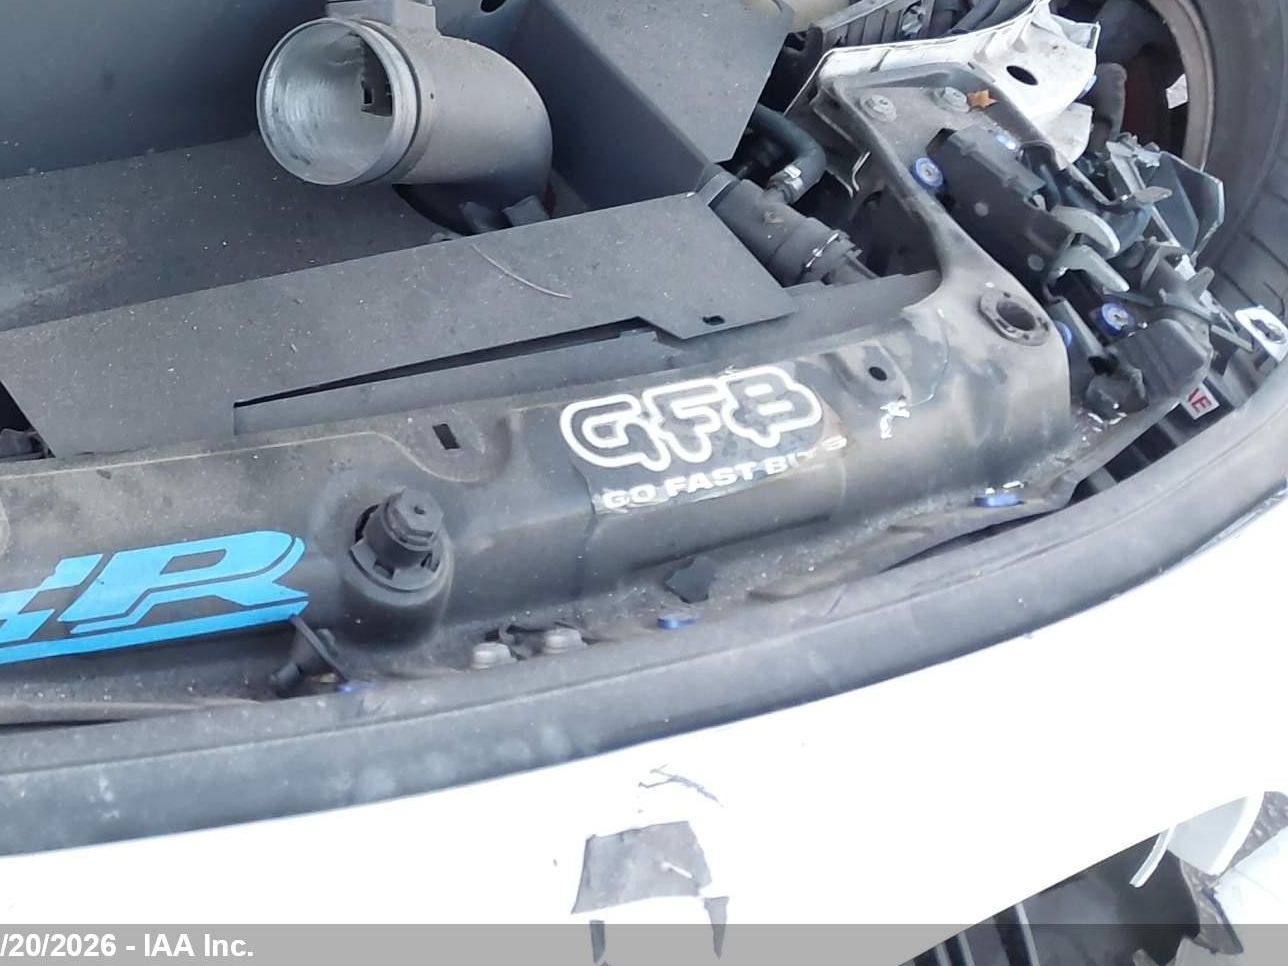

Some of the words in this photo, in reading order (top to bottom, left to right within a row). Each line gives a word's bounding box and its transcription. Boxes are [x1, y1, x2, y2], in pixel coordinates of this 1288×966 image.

[560, 365, 822, 472] GFB
[602, 484, 658, 510] GO
[663, 461, 756, 497] FAST
